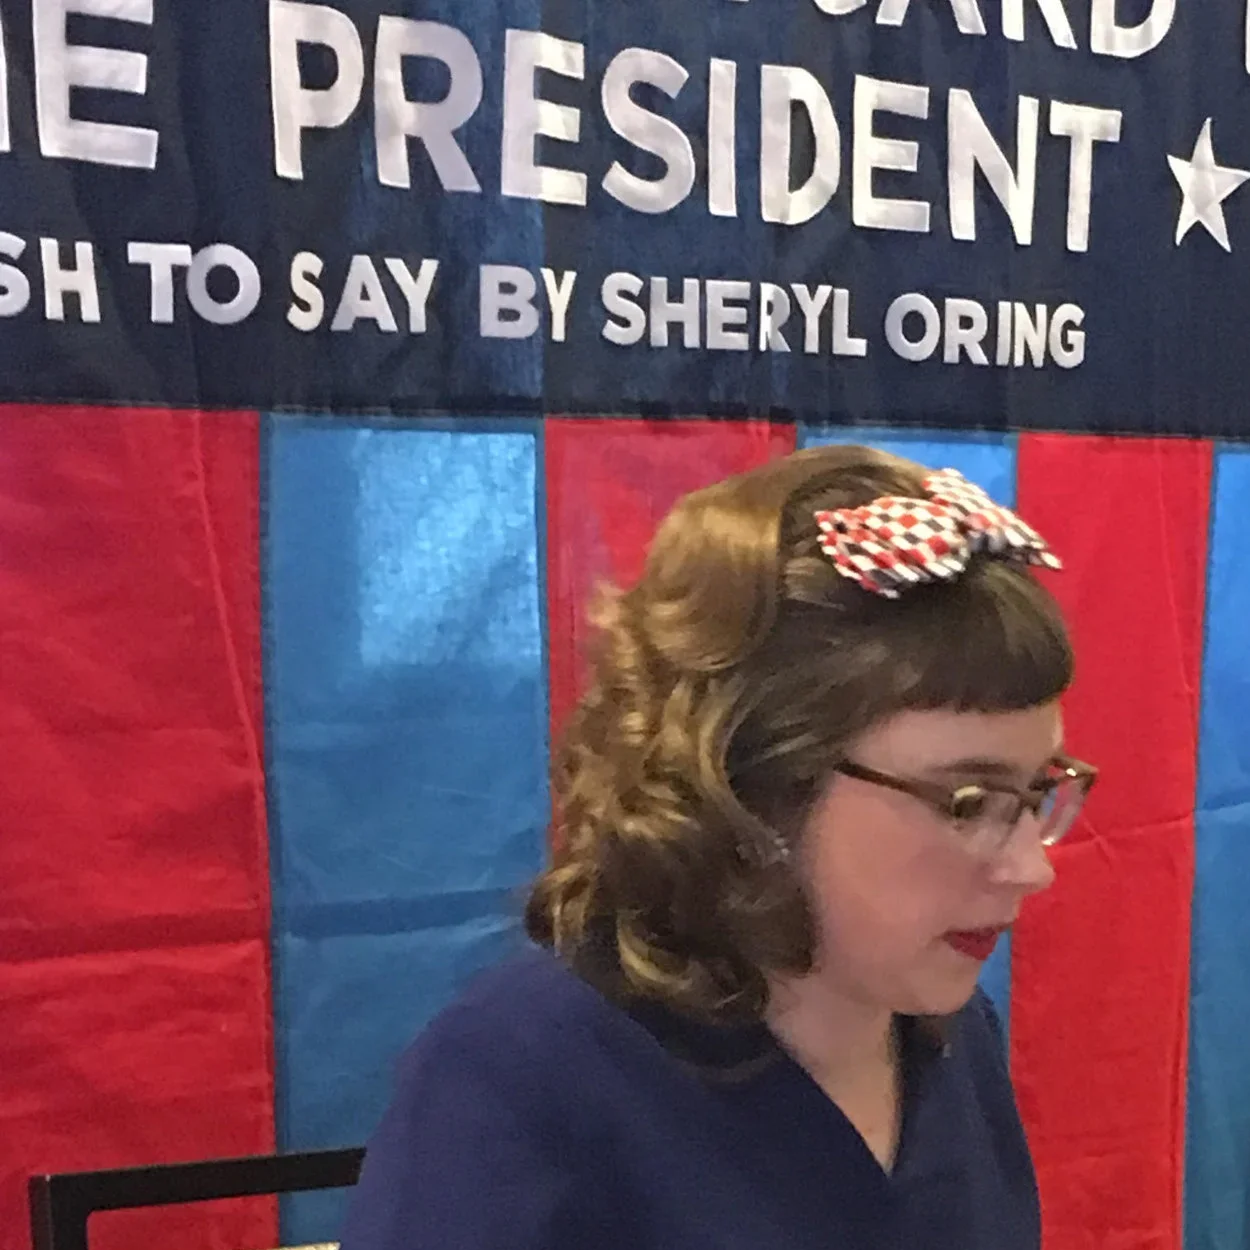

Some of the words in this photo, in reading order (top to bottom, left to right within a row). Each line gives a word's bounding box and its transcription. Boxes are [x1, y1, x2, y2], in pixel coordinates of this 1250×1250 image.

[268, 0, 1122, 253] PRESIDENT
[128, 242, 261, 324] TO
[287, 251, 439, 333] SAY
[479, 264, 578, 342] BY
[601, 272, 868, 357] SHERYL
[885, 292, 1086, 369] ORING
